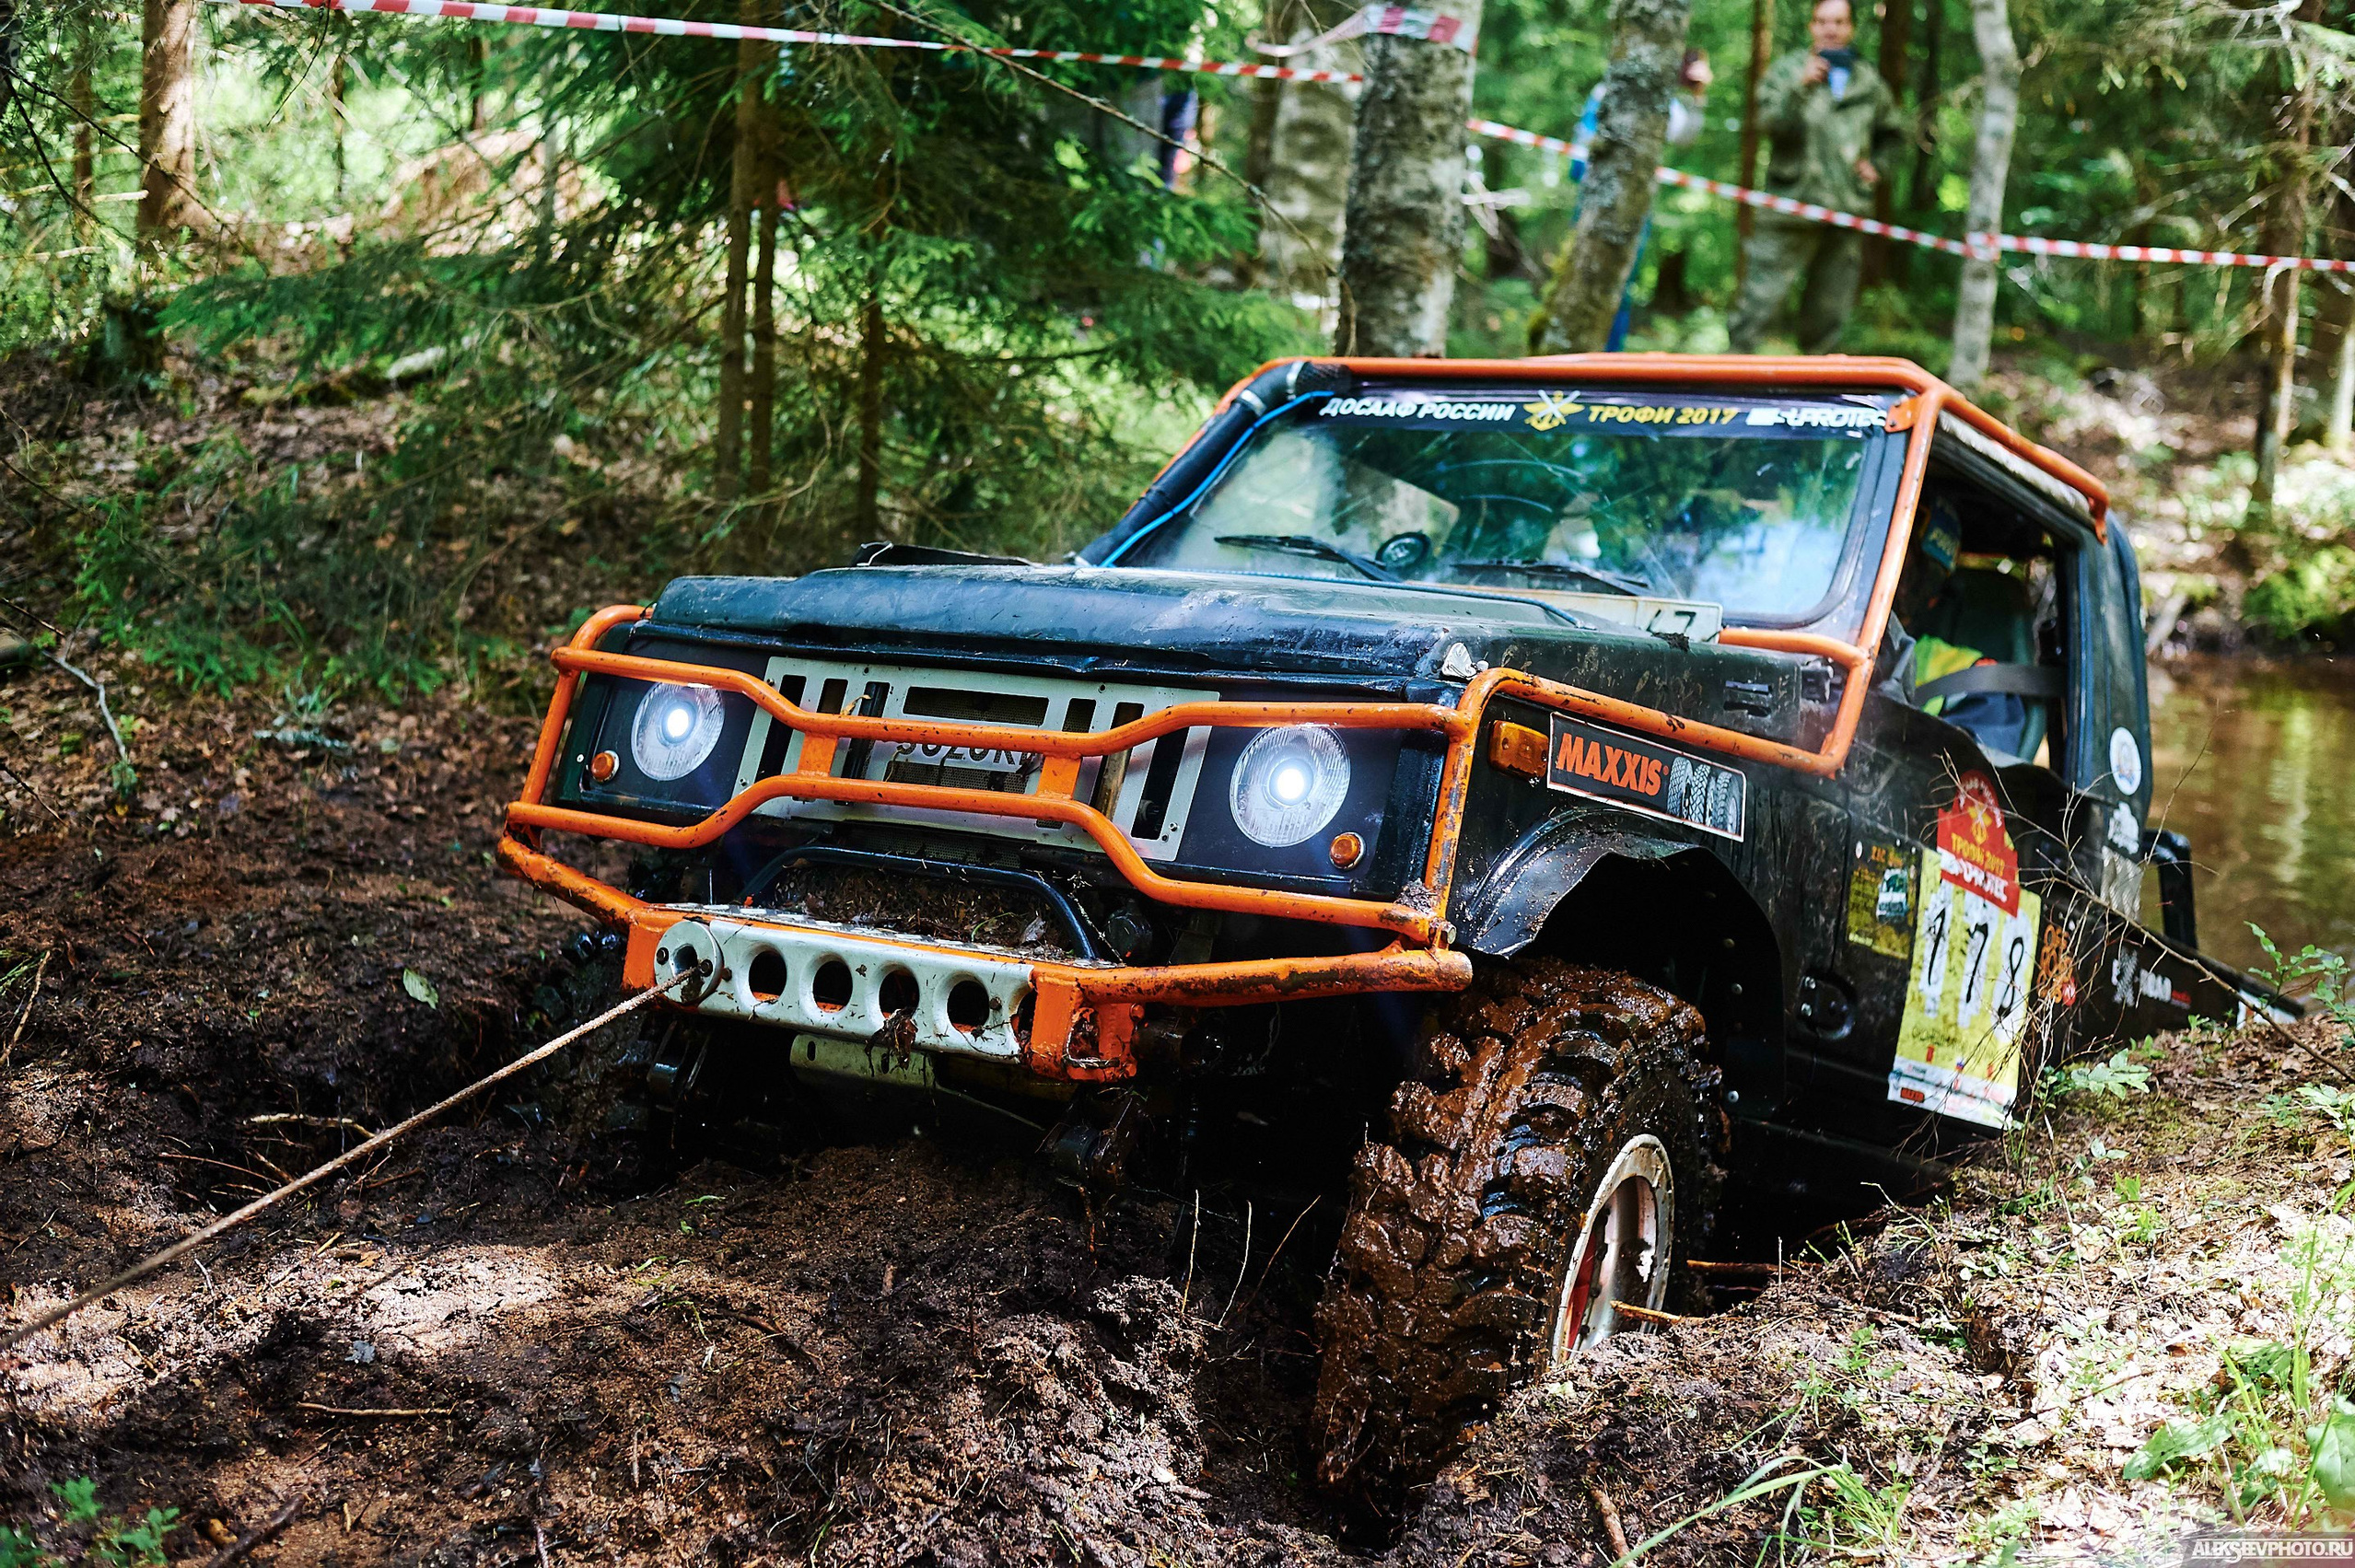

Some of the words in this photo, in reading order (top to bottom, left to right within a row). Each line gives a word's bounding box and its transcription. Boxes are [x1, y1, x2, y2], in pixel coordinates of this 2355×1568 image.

[1319, 397, 1417, 417] ДОСААФ
[1417, 402, 1516, 422] РОССИИ
[1589, 405, 1676, 424] ТРОФИ
[1676, 407, 1739, 424] 2017
[1556, 732, 1662, 796] MAXXIS
[1928, 907, 2024, 1022] 178
